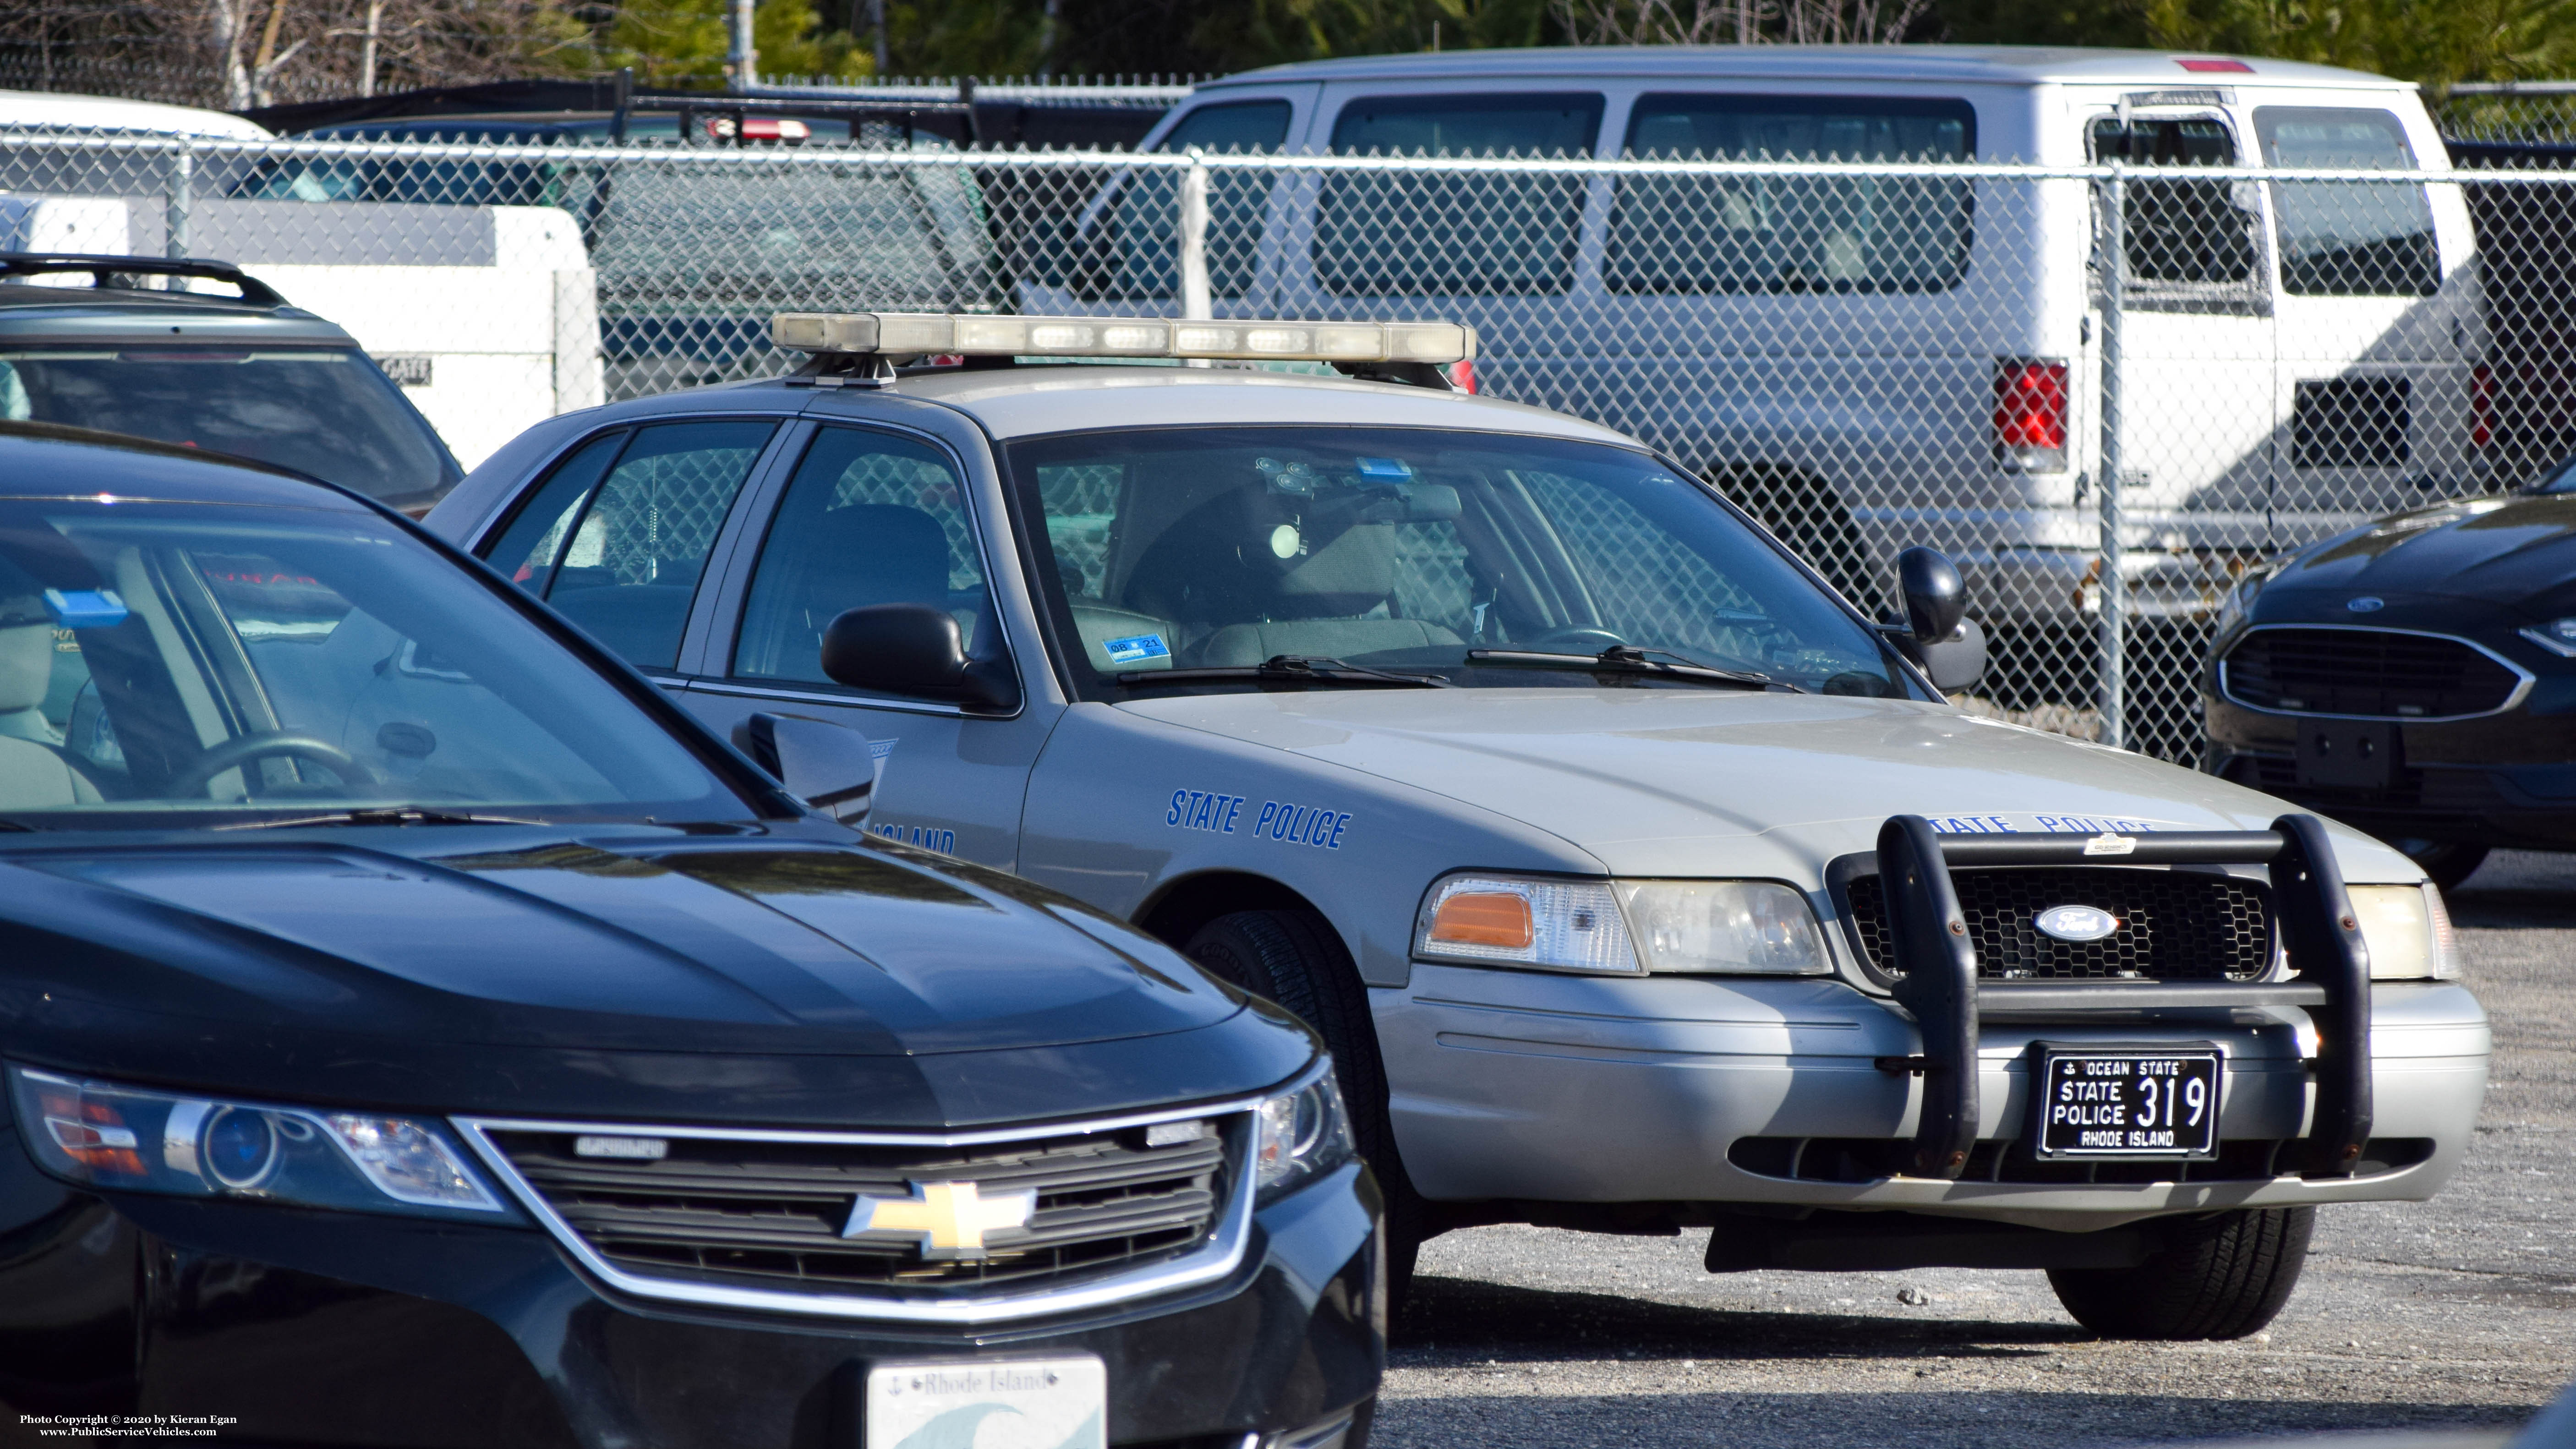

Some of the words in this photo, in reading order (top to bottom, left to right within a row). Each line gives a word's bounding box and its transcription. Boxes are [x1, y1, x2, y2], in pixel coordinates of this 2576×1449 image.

[1111, 644, 1128, 652] 08
[1143, 639, 1160, 648] 21
[1166, 788, 1246, 834] STATE
[1252, 800, 1353, 850] POLICE
[1928, 815, 2020, 833] TATE
[2056, 912, 2099, 931] Ford
[2086, 1061, 2130, 1076] OCEAN
[2139, 1061, 2179, 1076] STATE
[2061, 1081, 2122, 1102] STATE
[2137, 1077, 2205, 1127] 319
[2053, 1105, 2126, 1125] POLICE
[2081, 1130, 2122, 1147] RHODE
[2128, 1130, 2174, 1147] ISLAND
[924, 1371, 981, 1395] Rhode
[990, 1368, 1048, 1392] Island
